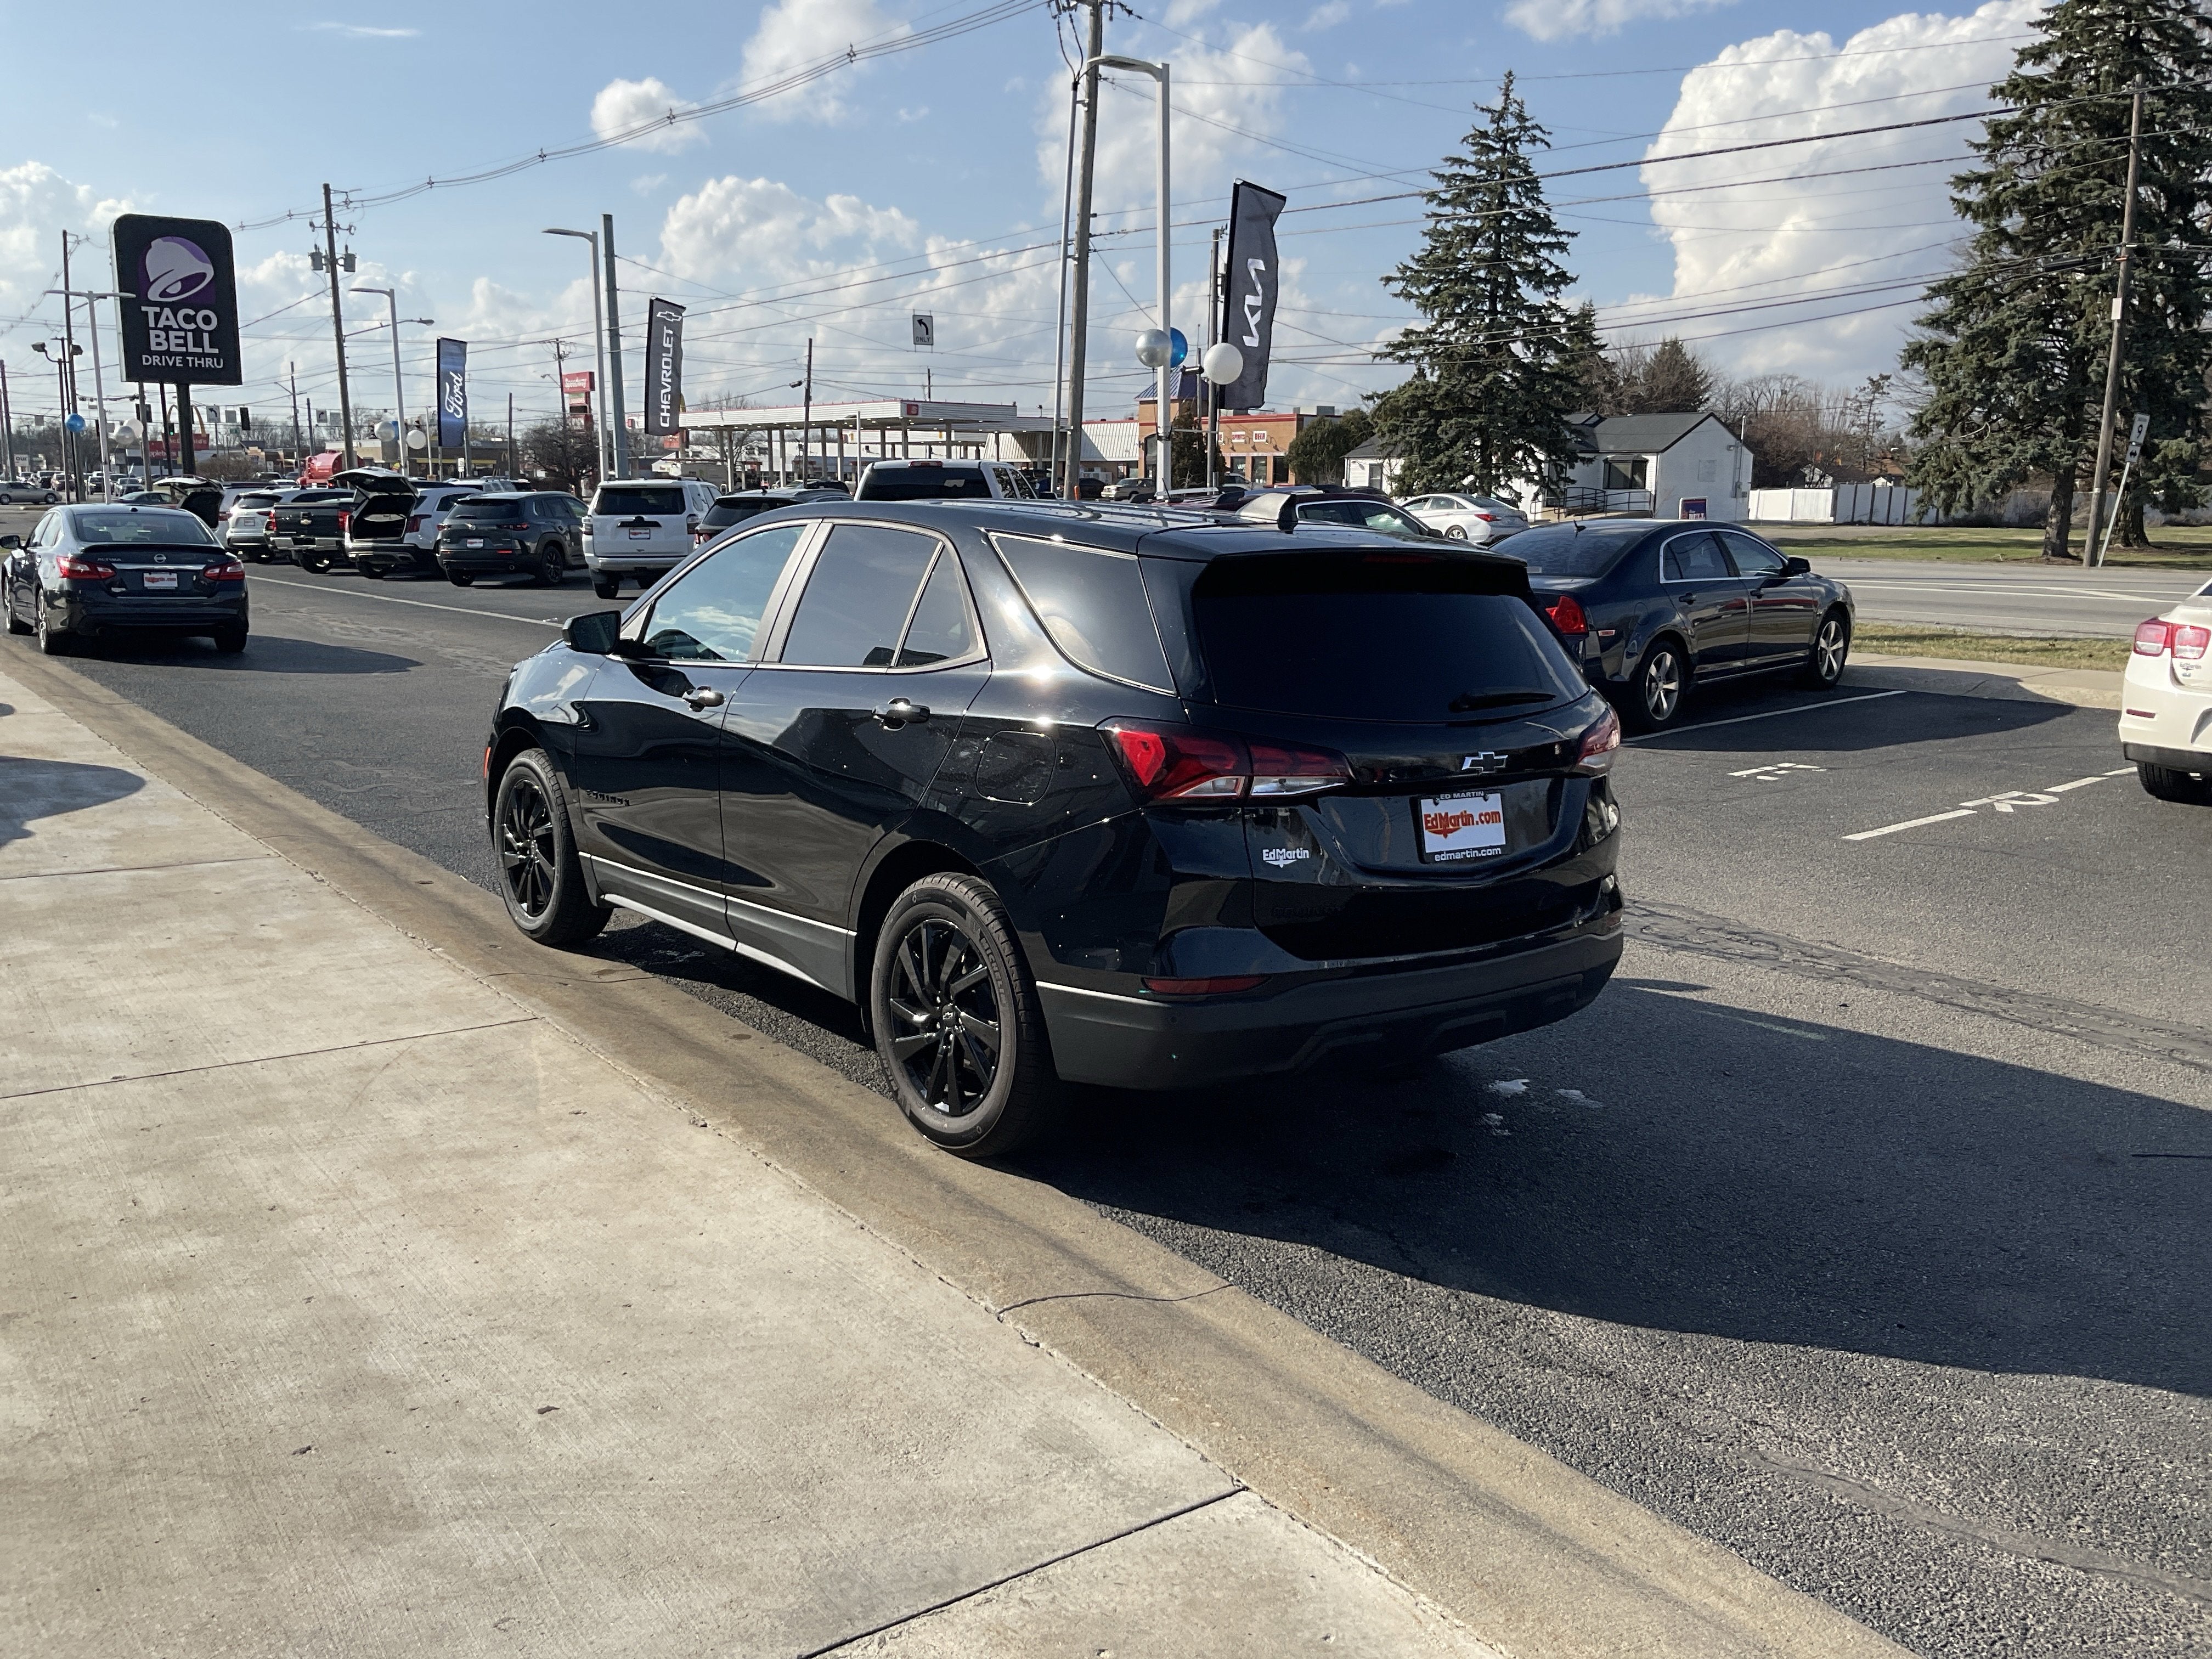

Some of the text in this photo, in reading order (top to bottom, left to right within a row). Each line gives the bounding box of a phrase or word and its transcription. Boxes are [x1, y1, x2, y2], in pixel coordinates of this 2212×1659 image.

[140, 306, 218, 331] TACO
[149, 329, 219, 354] BELL
[142, 354, 224, 369] DRIVE THRU
[660, 325, 674, 427] CHEVROLET
[445, 371, 464, 419] Ford
[2136, 424, 2143, 439] 9
[1453, 791, 1485, 799] MARTIN
[1423, 810, 1502, 831] EdMartin.com
[1262, 847, 1310, 861] EdMartin
[1434, 847, 1502, 862] edmartin.com
